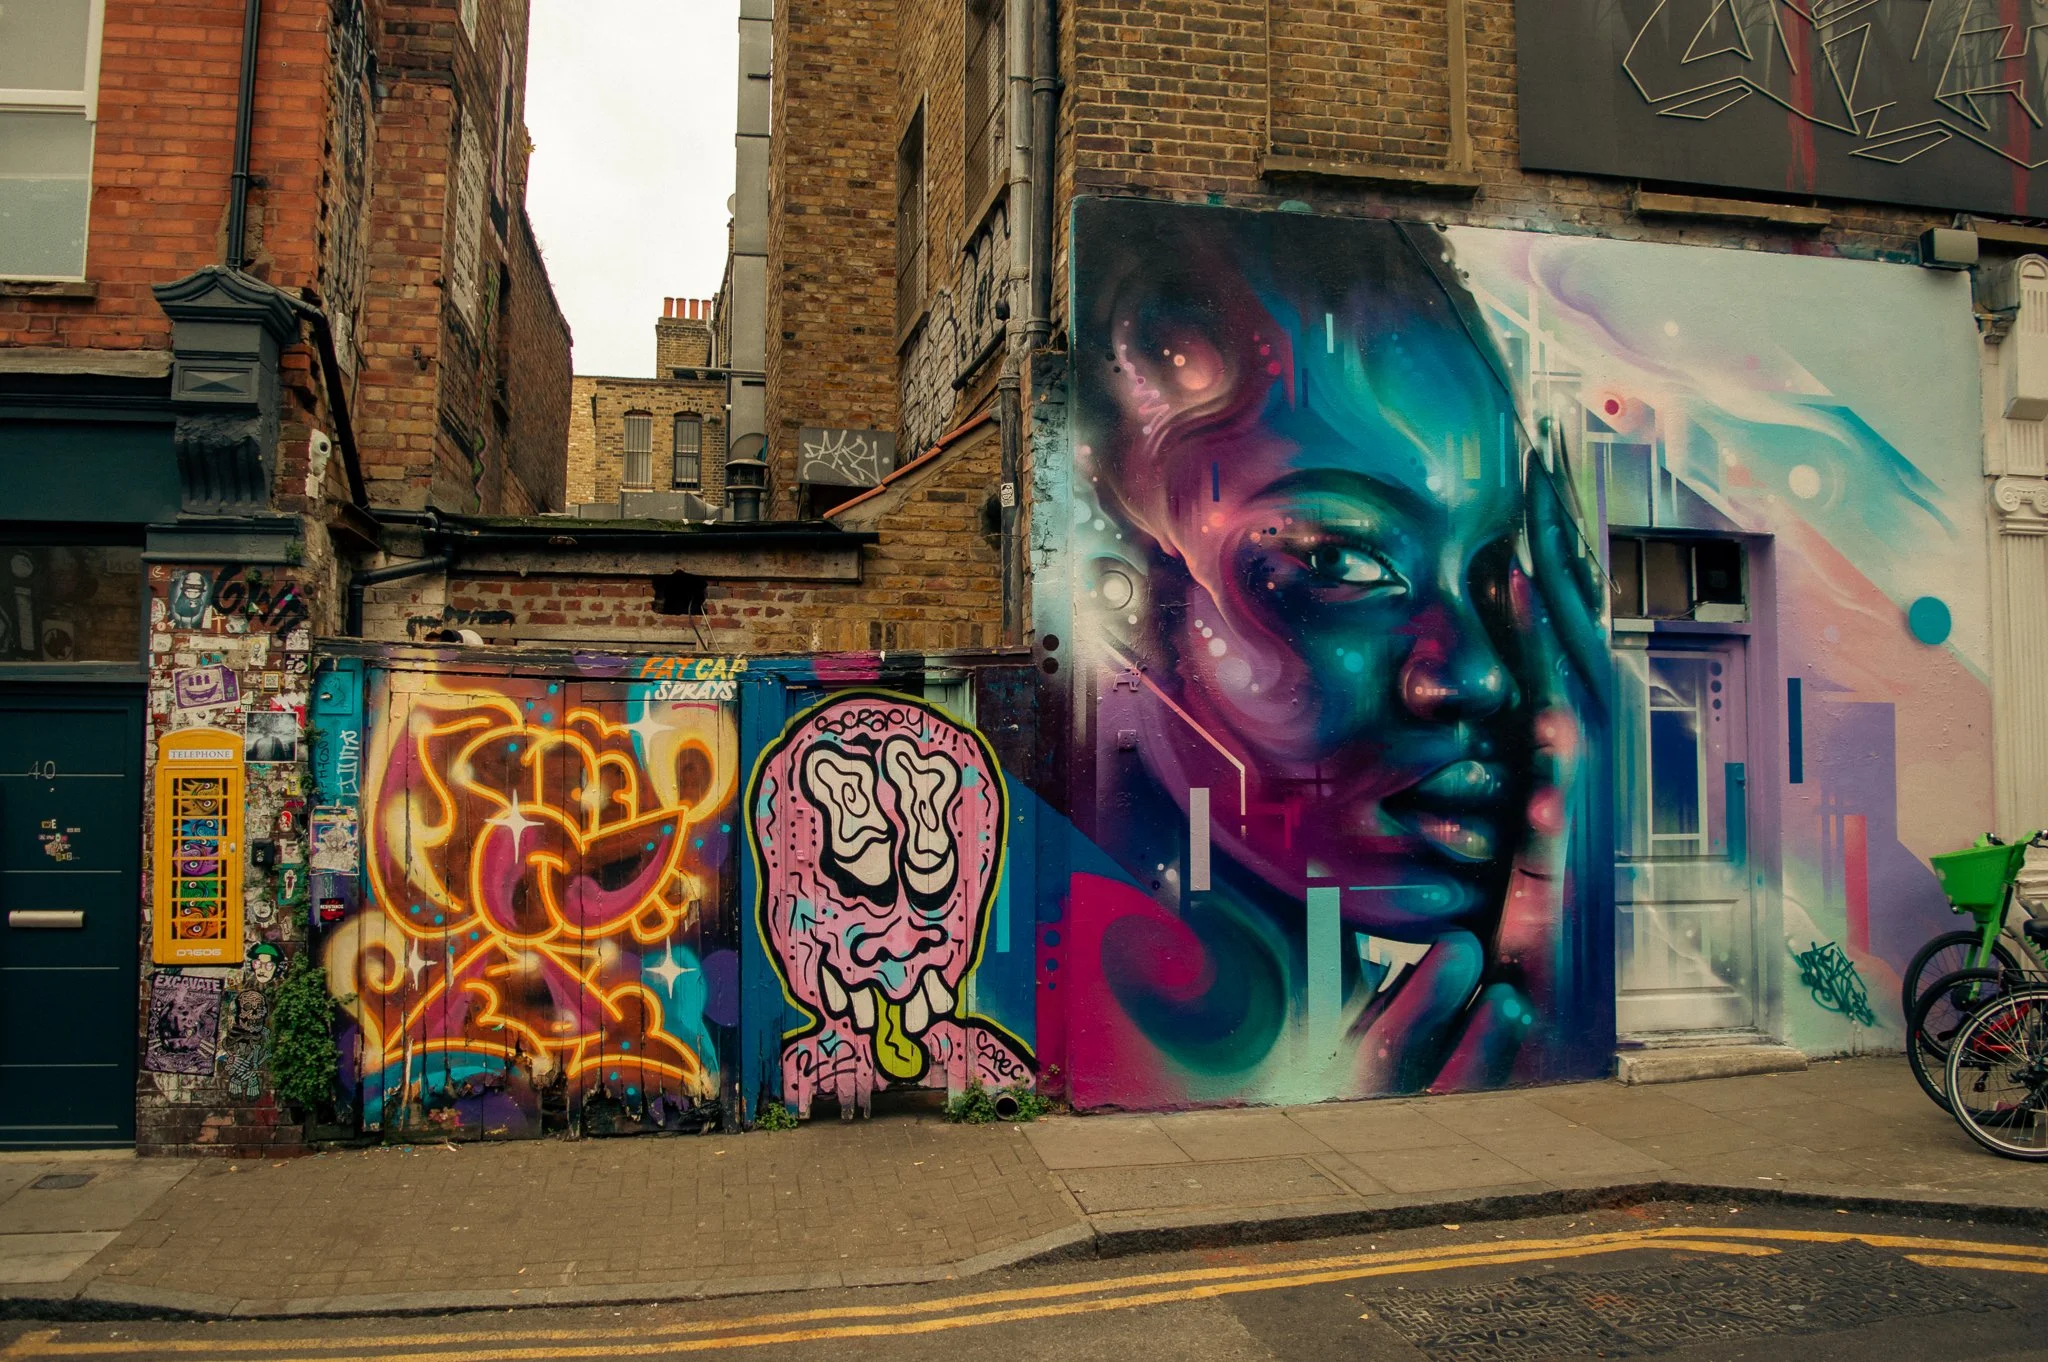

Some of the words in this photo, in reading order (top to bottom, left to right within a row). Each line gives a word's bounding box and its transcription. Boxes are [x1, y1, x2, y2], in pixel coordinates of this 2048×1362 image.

[640, 656, 695, 679] FAT
[695, 657, 748, 680] CAP
[654, 680, 738, 700] SPRAYS
[171, 750, 231, 759] TELEPHONE
[28, 760, 56, 780] 40
[155, 974, 222, 992] EXCAVATE
